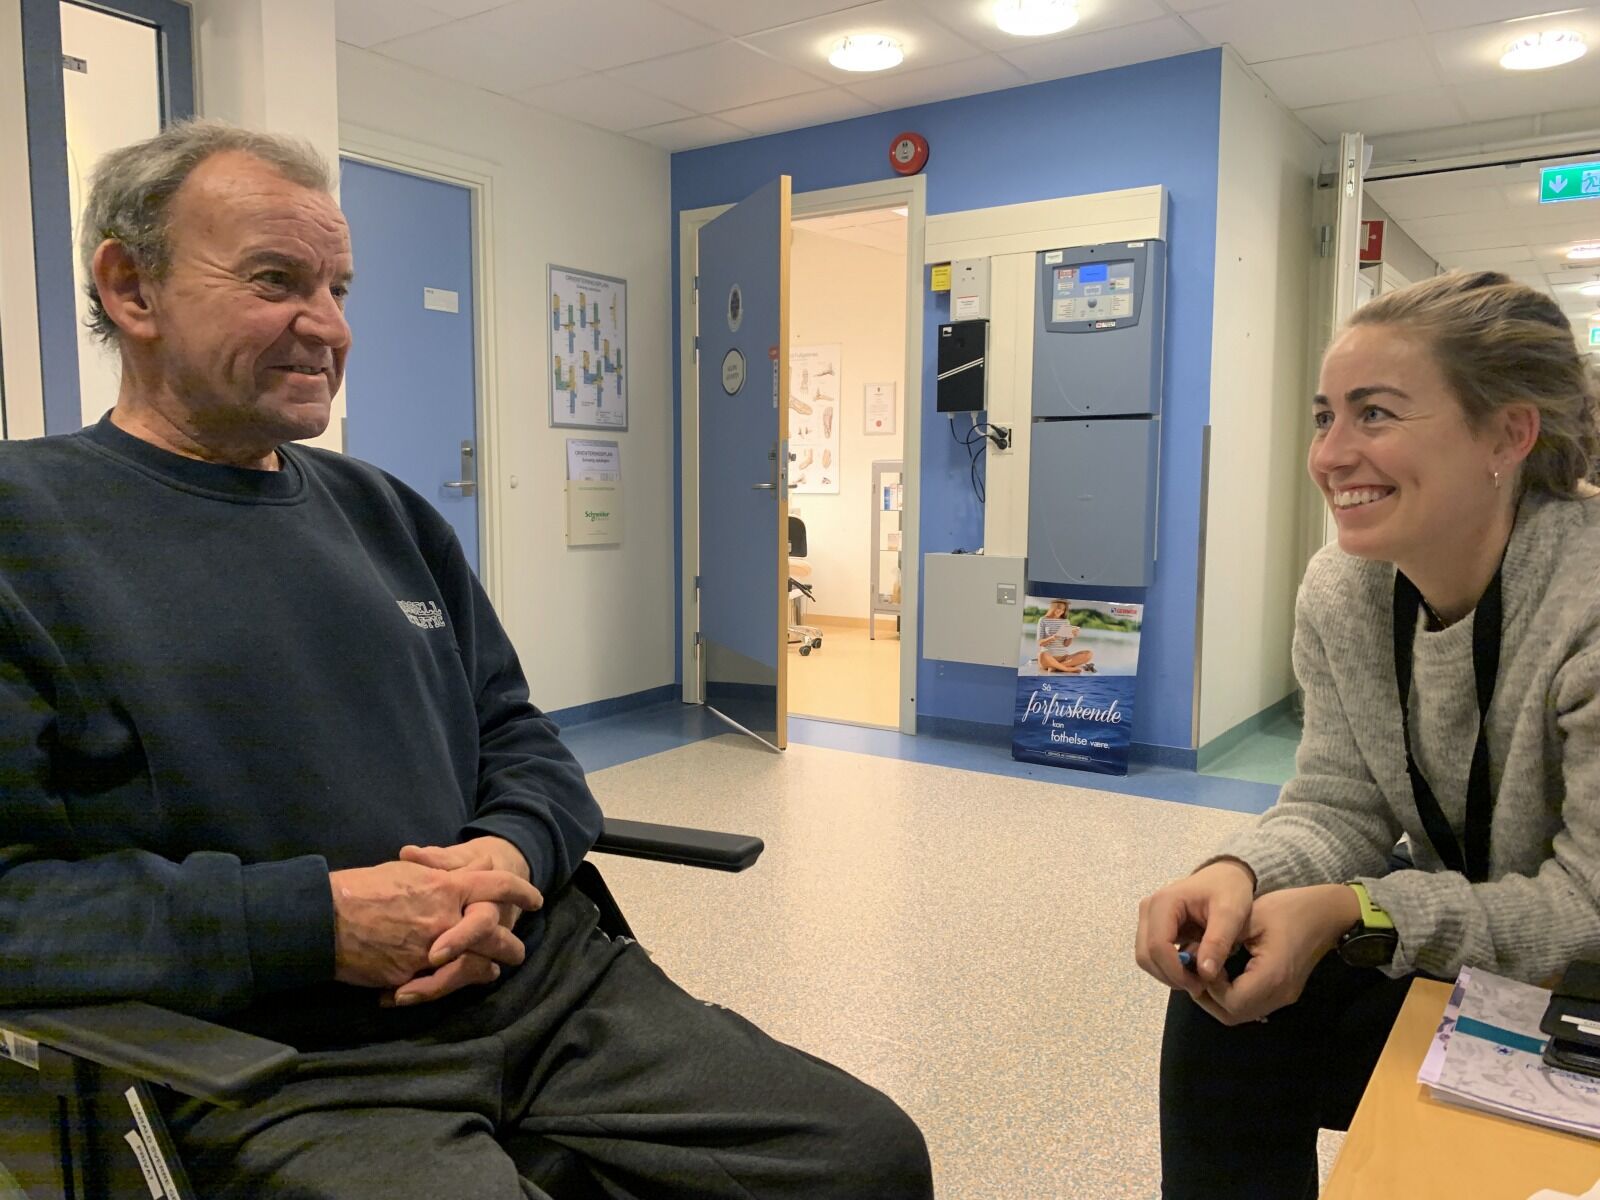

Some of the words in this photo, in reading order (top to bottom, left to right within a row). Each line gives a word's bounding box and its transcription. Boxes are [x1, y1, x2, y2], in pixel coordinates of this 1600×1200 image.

[1041, 682, 1052, 692] Så
[1021, 690, 1122, 725] forfriskende
[1052, 719, 1065, 729] kan
[1050, 729, 1088, 746] fothelse
[1089, 740, 1110, 749] være.
[136, 1144, 154, 1180] PRIVAT
